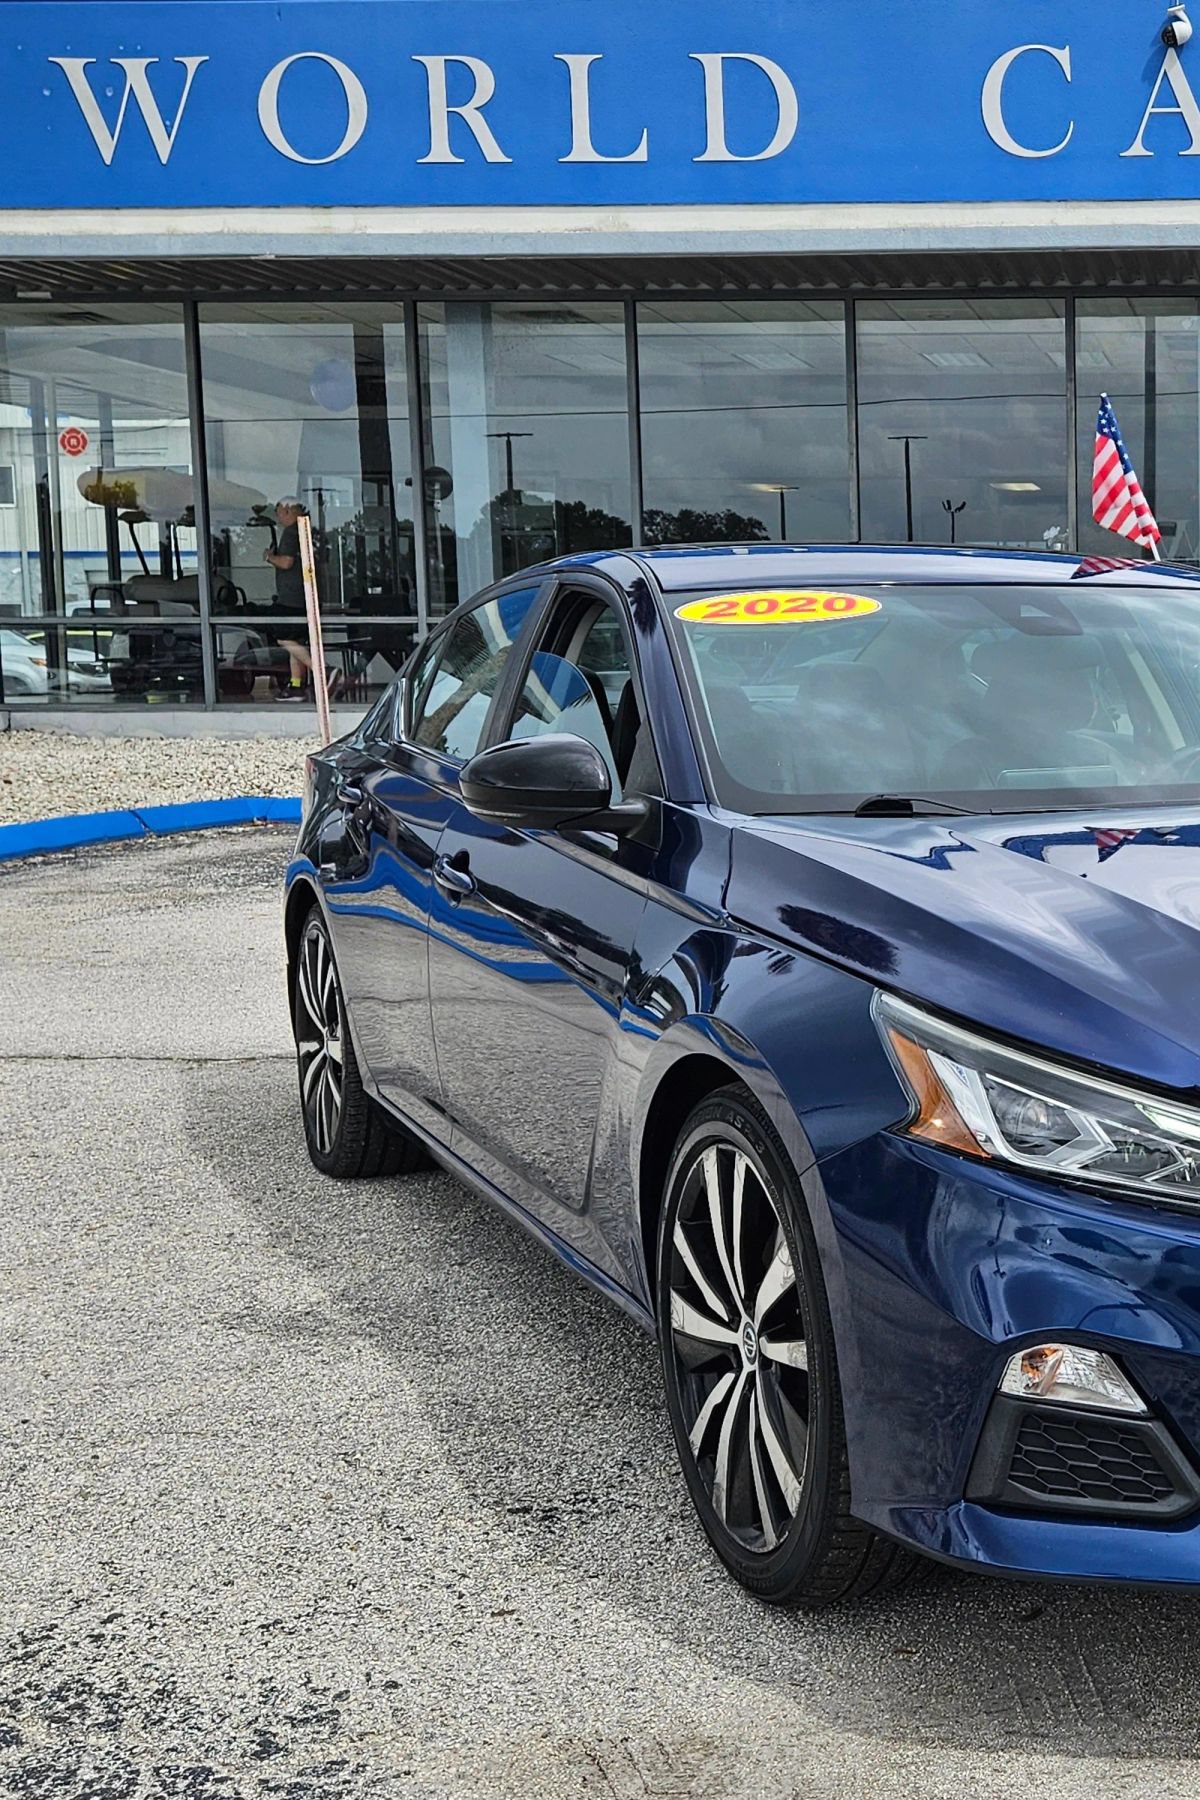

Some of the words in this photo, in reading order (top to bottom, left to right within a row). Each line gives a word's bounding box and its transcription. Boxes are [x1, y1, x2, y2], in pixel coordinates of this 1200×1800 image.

[48, 51, 799, 166] WORLD
[703, 597, 856, 619] 2020
[743, 1191, 822, 1220] NISSAN
